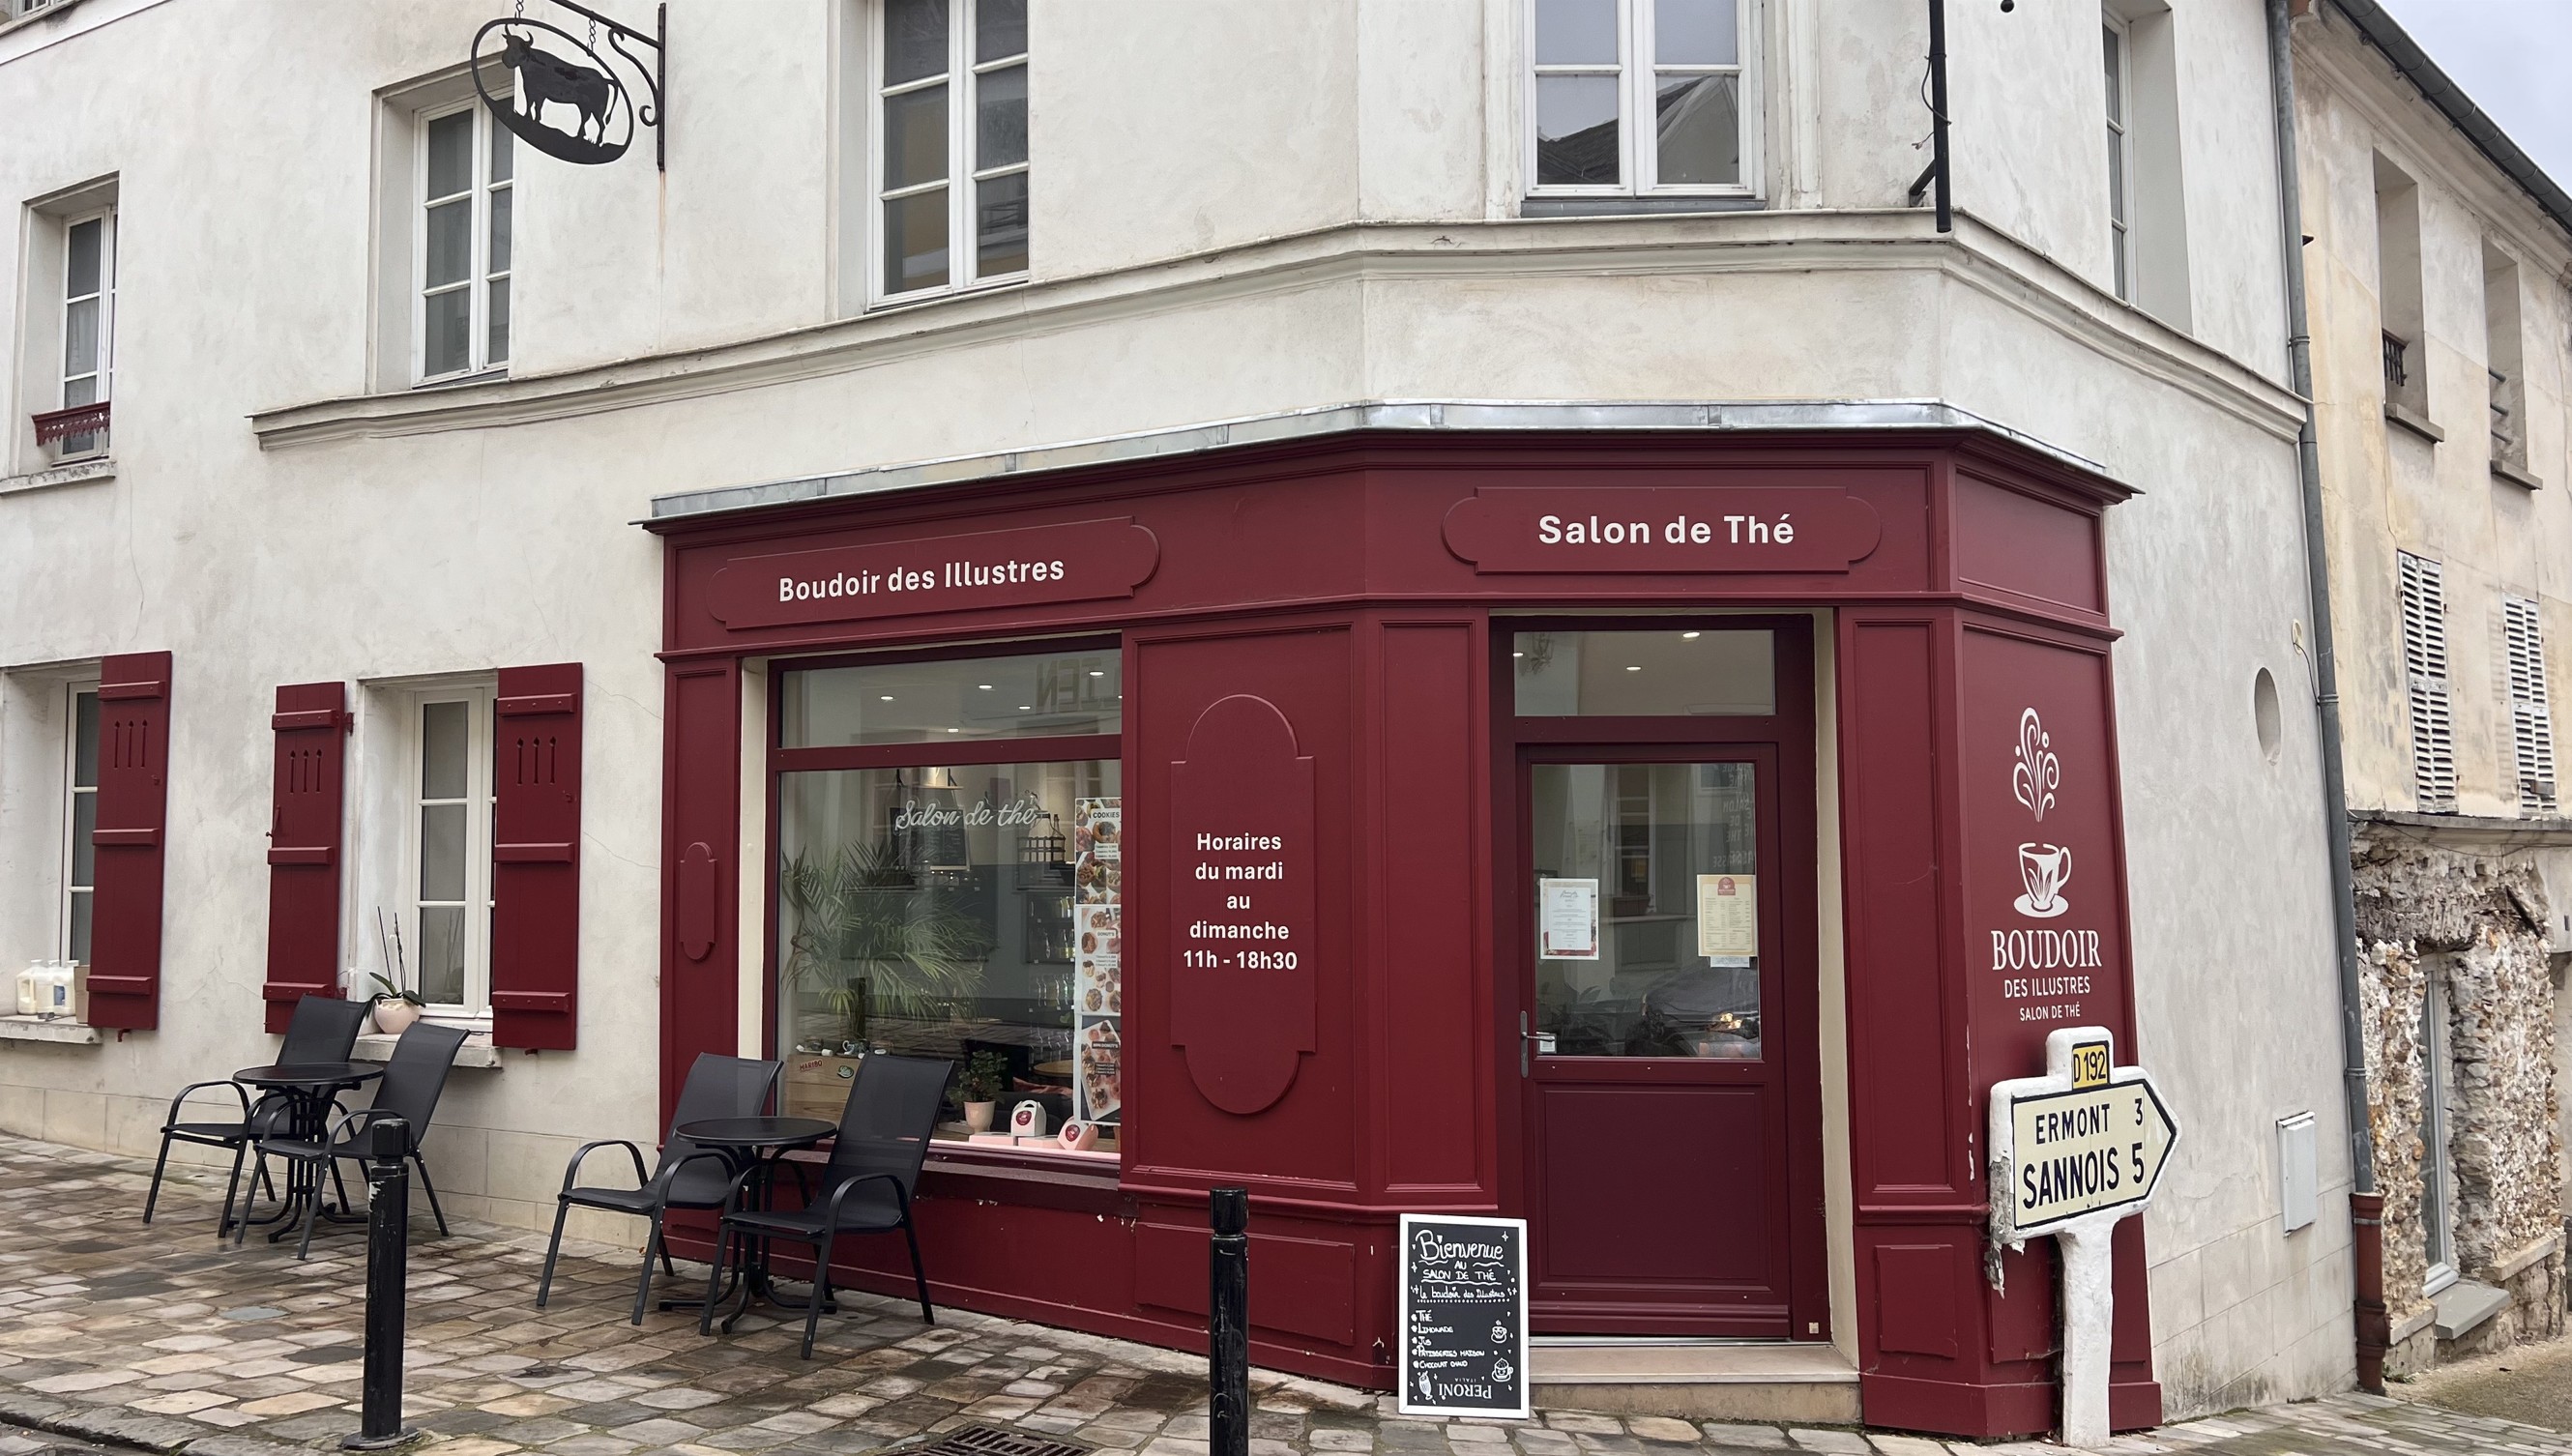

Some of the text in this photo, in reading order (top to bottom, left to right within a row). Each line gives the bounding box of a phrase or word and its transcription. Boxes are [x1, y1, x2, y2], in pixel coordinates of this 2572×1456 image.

[1538, 512, 1795, 544] Salon de Thé
[778, 559, 1066, 602] Boudoir des Illustres
[893, 799, 963, 831] Salon
[965, 800, 995, 827] de
[1196, 831, 1282, 851] Horaires
[1194, 861, 1284, 880] du mardi
[1226, 895, 1250, 910] au
[1189, 920, 1290, 940] dimanche
[1183, 949, 1217, 968] 11h
[1236, 950, 1298, 970] 18h30
[1990, 929, 2103, 971] BOUDOIR
[2003, 976, 2090, 999] DES ILLUSTRES
[2019, 1001, 2081, 1022] SALON DE THÉ
[799, 1059, 823, 1071] HARIBO
[2072, 1050, 2107, 1083] D 192
[2035, 1097, 2144, 1146] ERMONT 3
[2022, 1142, 2145, 1209] SANNOIS 5
[1415, 1229, 1505, 1261] Bienvenue
[1422, 1268, 1497, 1282] SALON DE THÉ
[1453, 1260, 1468, 1270] AU
[1463, 1289, 1475, 1298] des
[1438, 1383, 1493, 1400] PERONI
